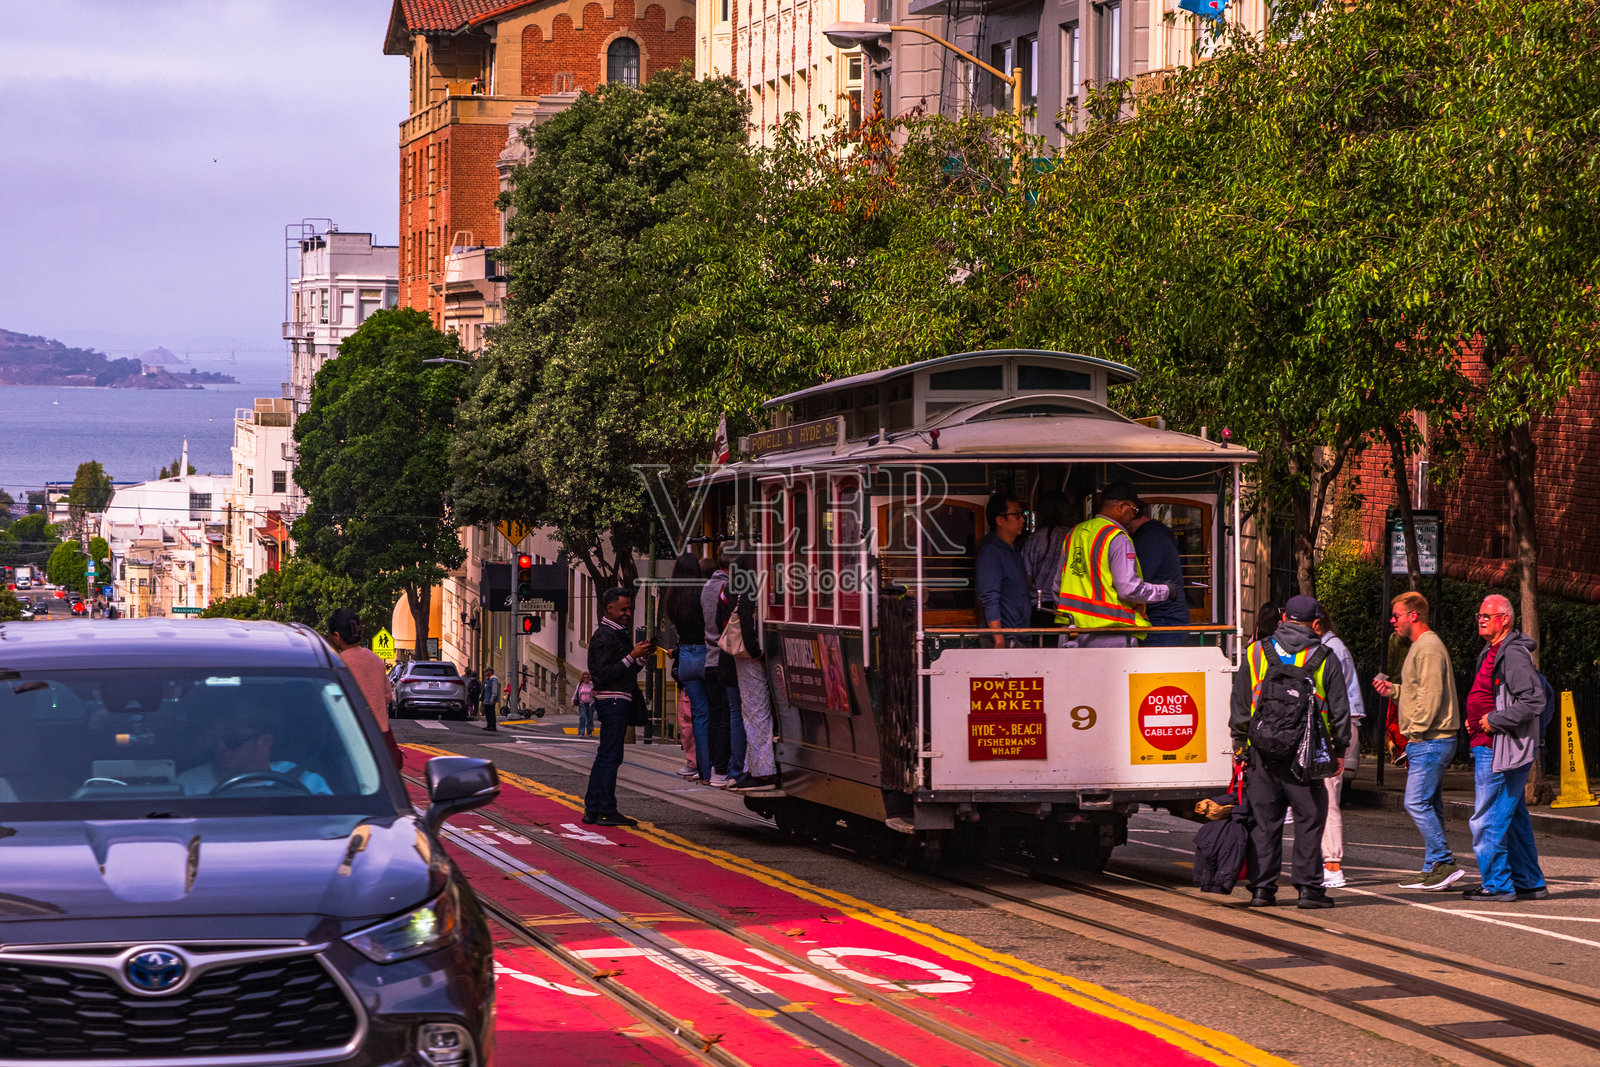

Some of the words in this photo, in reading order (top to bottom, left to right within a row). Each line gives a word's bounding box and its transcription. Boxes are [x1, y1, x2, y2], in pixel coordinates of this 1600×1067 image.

[752, 434, 782, 451] POWELL
[800, 424, 821, 442] HYDE
[520, 602, 553, 611] SACRAMENTO
[972, 680, 1042, 691] POWELL
[991, 691, 1025, 699] AND
[1148, 695, 1164, 705] DO
[1166, 694, 1189, 704] NOT
[971, 699, 1043, 711] MARKET
[1155, 704, 1183, 714] PASS
[1070, 705, 1098, 731] 9
[1566, 716, 1573, 728] NO
[971, 724, 996, 736] HYDE
[1011, 723, 1042, 736] BEACH
[1144, 728, 1173, 736] CABLE
[1175, 727, 1193, 736] CAR
[977, 737, 1037, 747] FISHERMANS
[991, 747, 1022, 755] WHARF
[1567, 730, 1576, 773] PARKING
